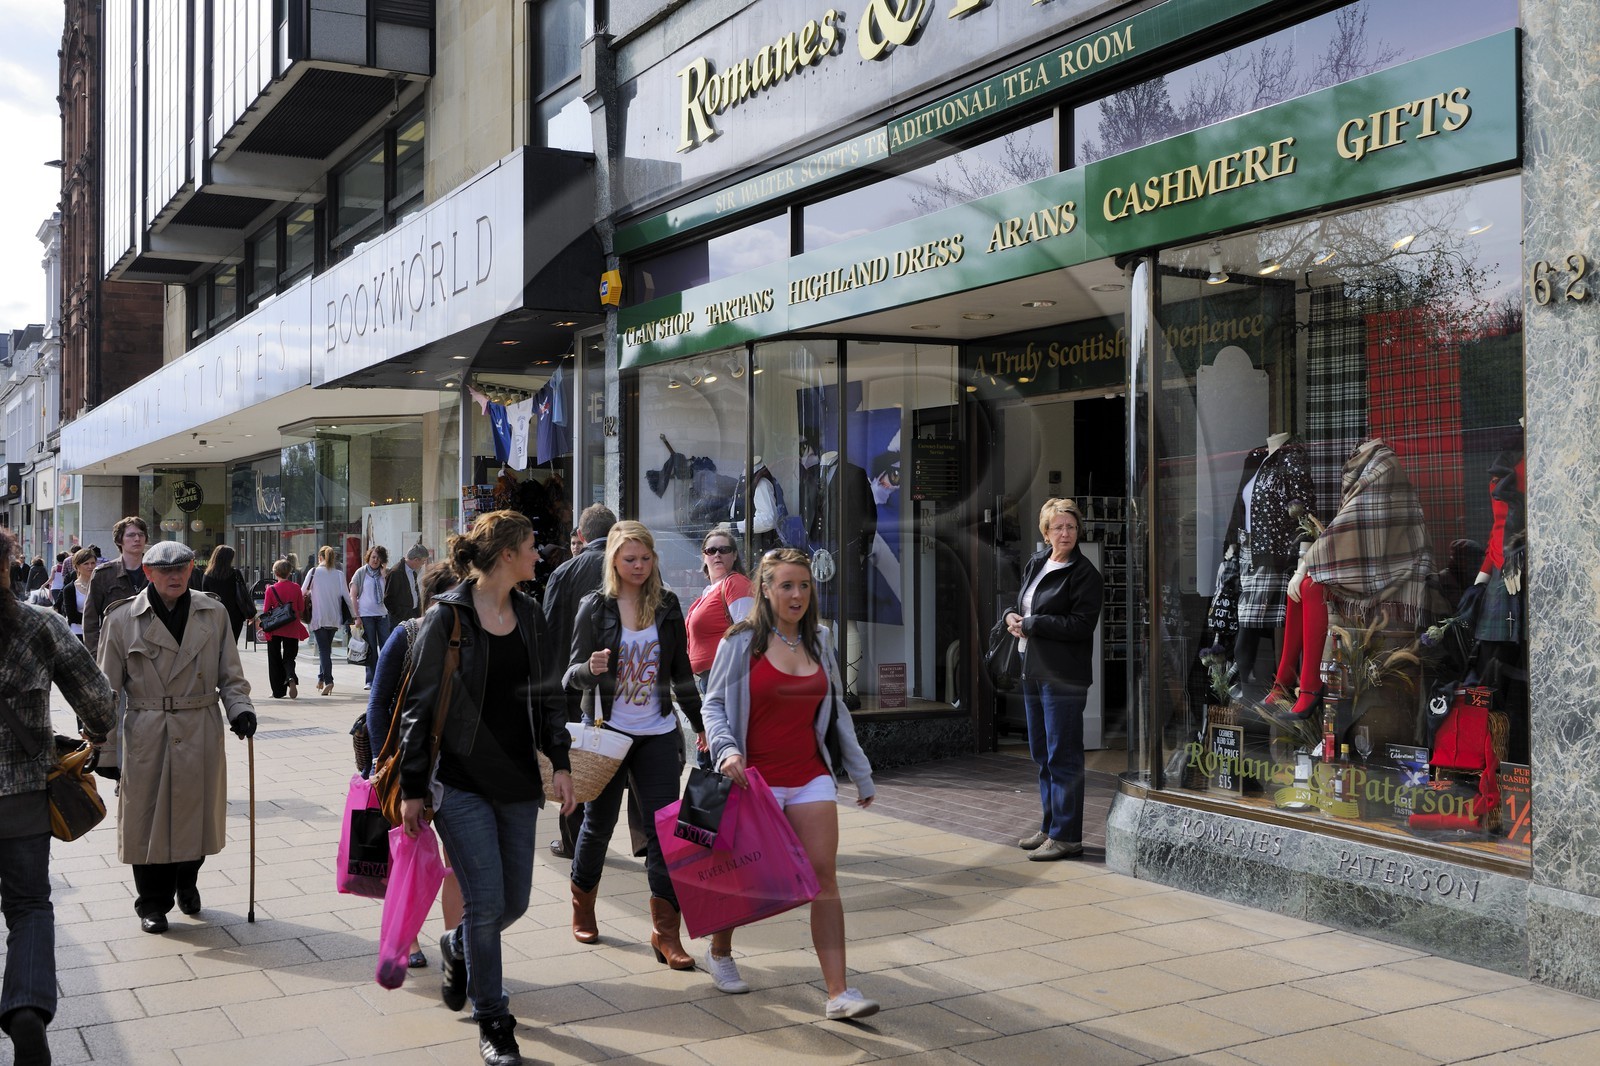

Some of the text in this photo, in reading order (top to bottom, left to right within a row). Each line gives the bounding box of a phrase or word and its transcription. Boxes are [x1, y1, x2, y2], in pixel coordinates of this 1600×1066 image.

[676, 8, 840, 153] Romanes
[715, 24, 1136, 214] SIR WALTER SCOTT'S TRADITIONAL TEA ROOM
[624, 86, 1472, 348] CLAN SHOP TARTANS HIGHLAND DRESS ARANS CASHMERE GIFTS
[326, 214, 493, 354] BOOKWORLD
[1530, 252, 1587, 307] 62
[182, 319, 286, 413] STORES
[971, 353, 986, 380] A
[991, 342, 1042, 383] Truly
[1048, 326, 1129, 369] Scottish
[603, 416, 617, 437] 62
[173, 480, 185, 489] WE
[175, 494, 198, 505] COFFEE
[1184, 740, 1478, 822] Romanes & Paterson
[1218, 774, 1232, 790] £15
[1502, 774, 1530, 785] CASHM
[1513, 768, 1530, 776] PUR
[1394, 806, 1413, 815] TASTIN
[697, 850, 762, 881] RIVER ISLAND
[1180, 816, 1480, 903] ROMANES PATERSON
